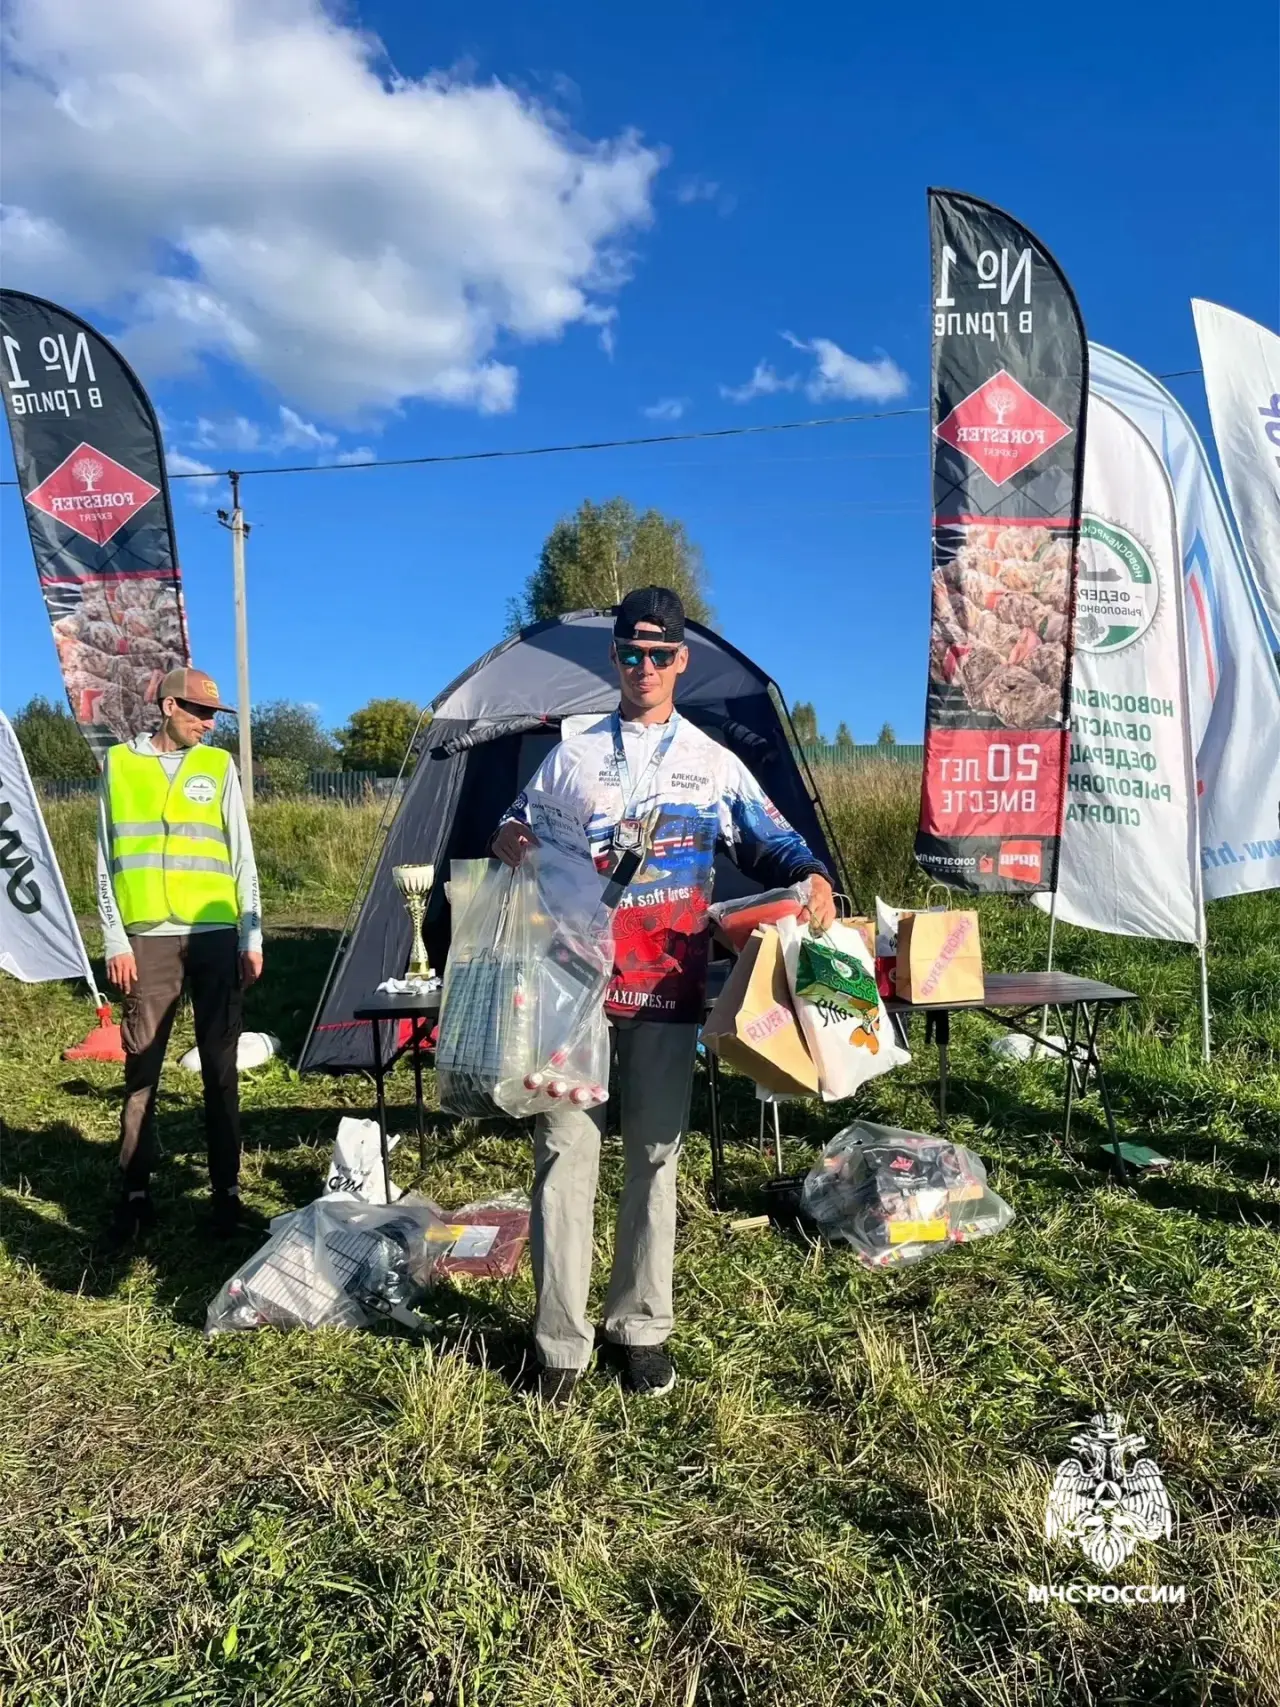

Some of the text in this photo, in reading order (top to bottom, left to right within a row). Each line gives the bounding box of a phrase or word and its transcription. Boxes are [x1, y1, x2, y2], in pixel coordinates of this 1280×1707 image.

[599, 770, 620, 778] RELA
[100, 873, 116, 929] FINNTRAIL
[637, 888, 665, 907] soft
[605, 988, 677, 1010] LAXLURES.ru
